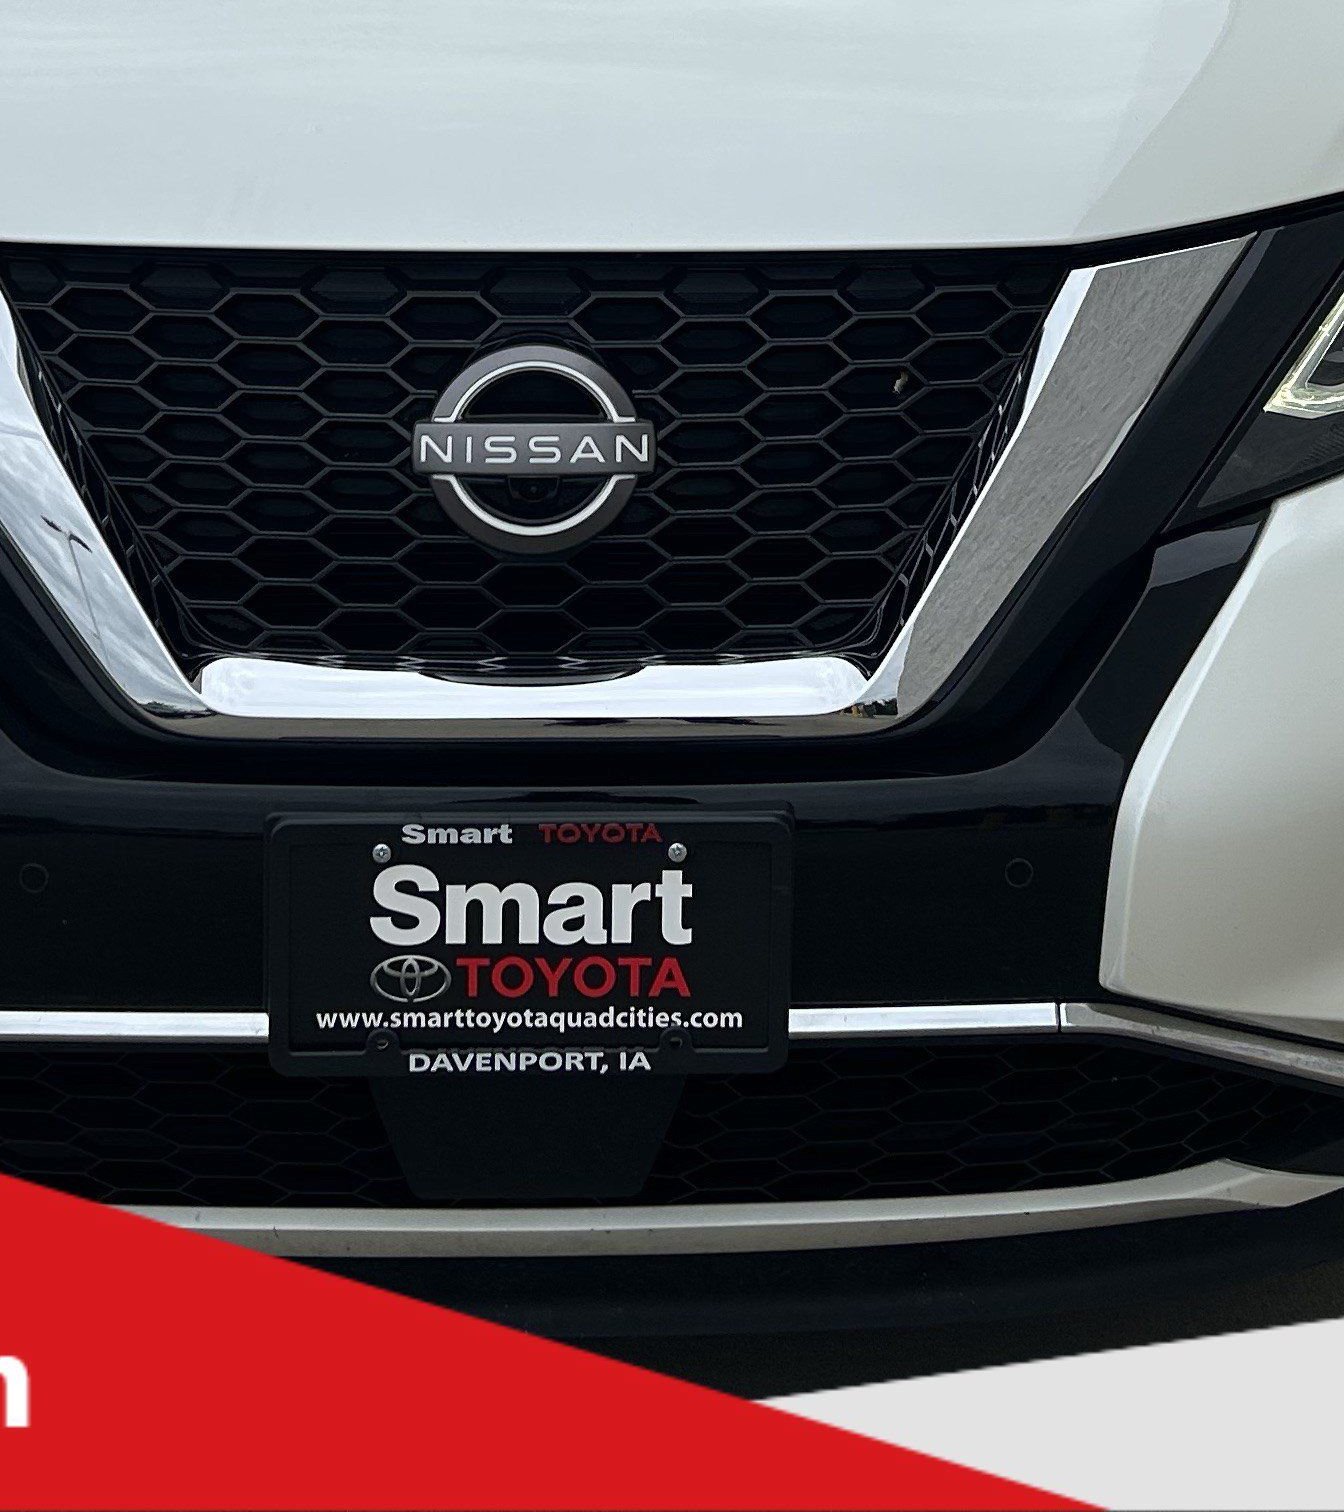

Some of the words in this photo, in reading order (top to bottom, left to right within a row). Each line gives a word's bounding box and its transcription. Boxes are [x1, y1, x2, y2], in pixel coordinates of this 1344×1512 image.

[419, 434, 649, 464] NISSAN
[401, 823, 513, 844] Smart
[538, 823, 663, 843] TOYOTA
[369, 863, 693, 946] Smart
[454, 952, 692, 999] TOYOTA
[315, 1006, 743, 1033] www.smarttoyotaquadcities.com
[408, 1051, 609, 1075] DAVENPORT,
[618, 1051, 652, 1072] IA
